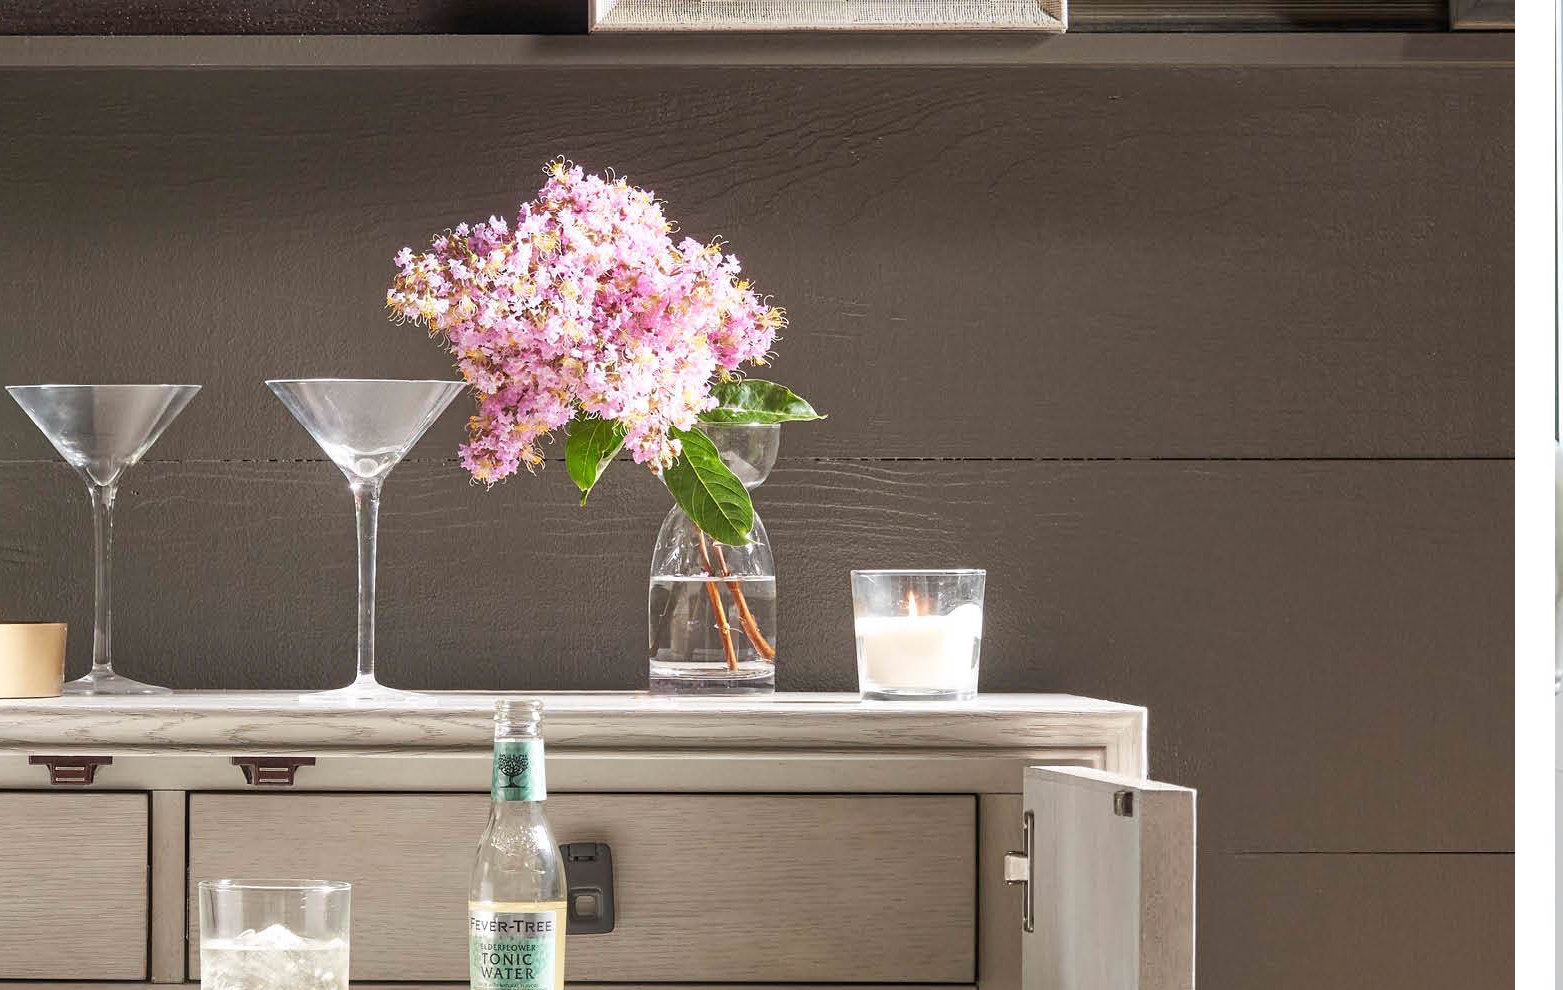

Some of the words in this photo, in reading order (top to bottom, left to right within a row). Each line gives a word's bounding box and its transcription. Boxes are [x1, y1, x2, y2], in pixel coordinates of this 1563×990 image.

[470, 917, 552, 933] FEVER-TREE
[480, 944, 536, 952] ELDERFLOWER
[481, 953, 532, 966] TONIC
[481, 967, 535, 980] WATER
